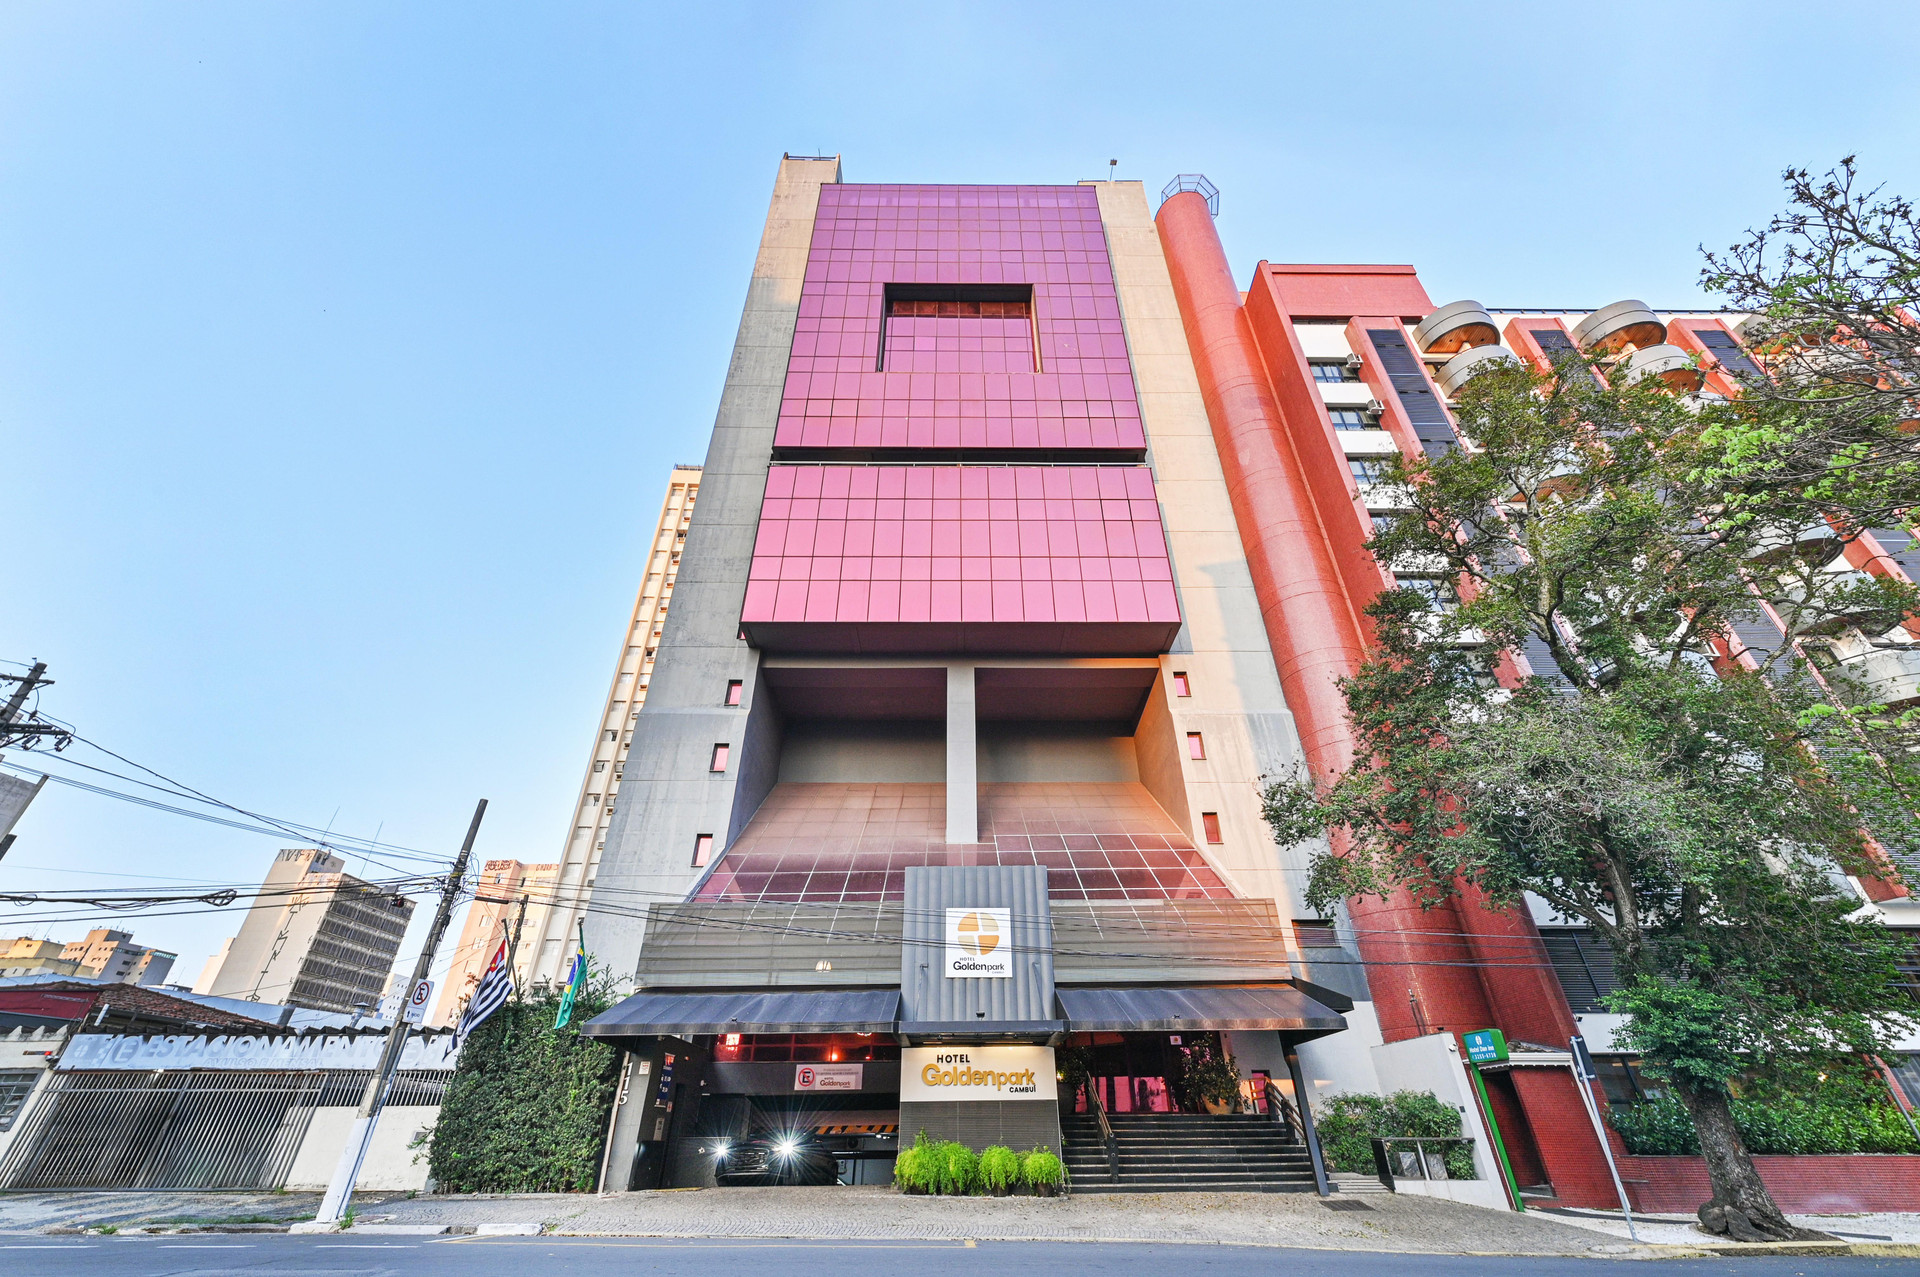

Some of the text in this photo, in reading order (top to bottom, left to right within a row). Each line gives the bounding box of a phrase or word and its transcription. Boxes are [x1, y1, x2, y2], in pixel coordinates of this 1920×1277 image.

[953, 961, 1005, 972] Goldenpark
[936, 1054, 970, 1063] HOTEL
[921, 1063, 1036, 1091] Goldenpark
